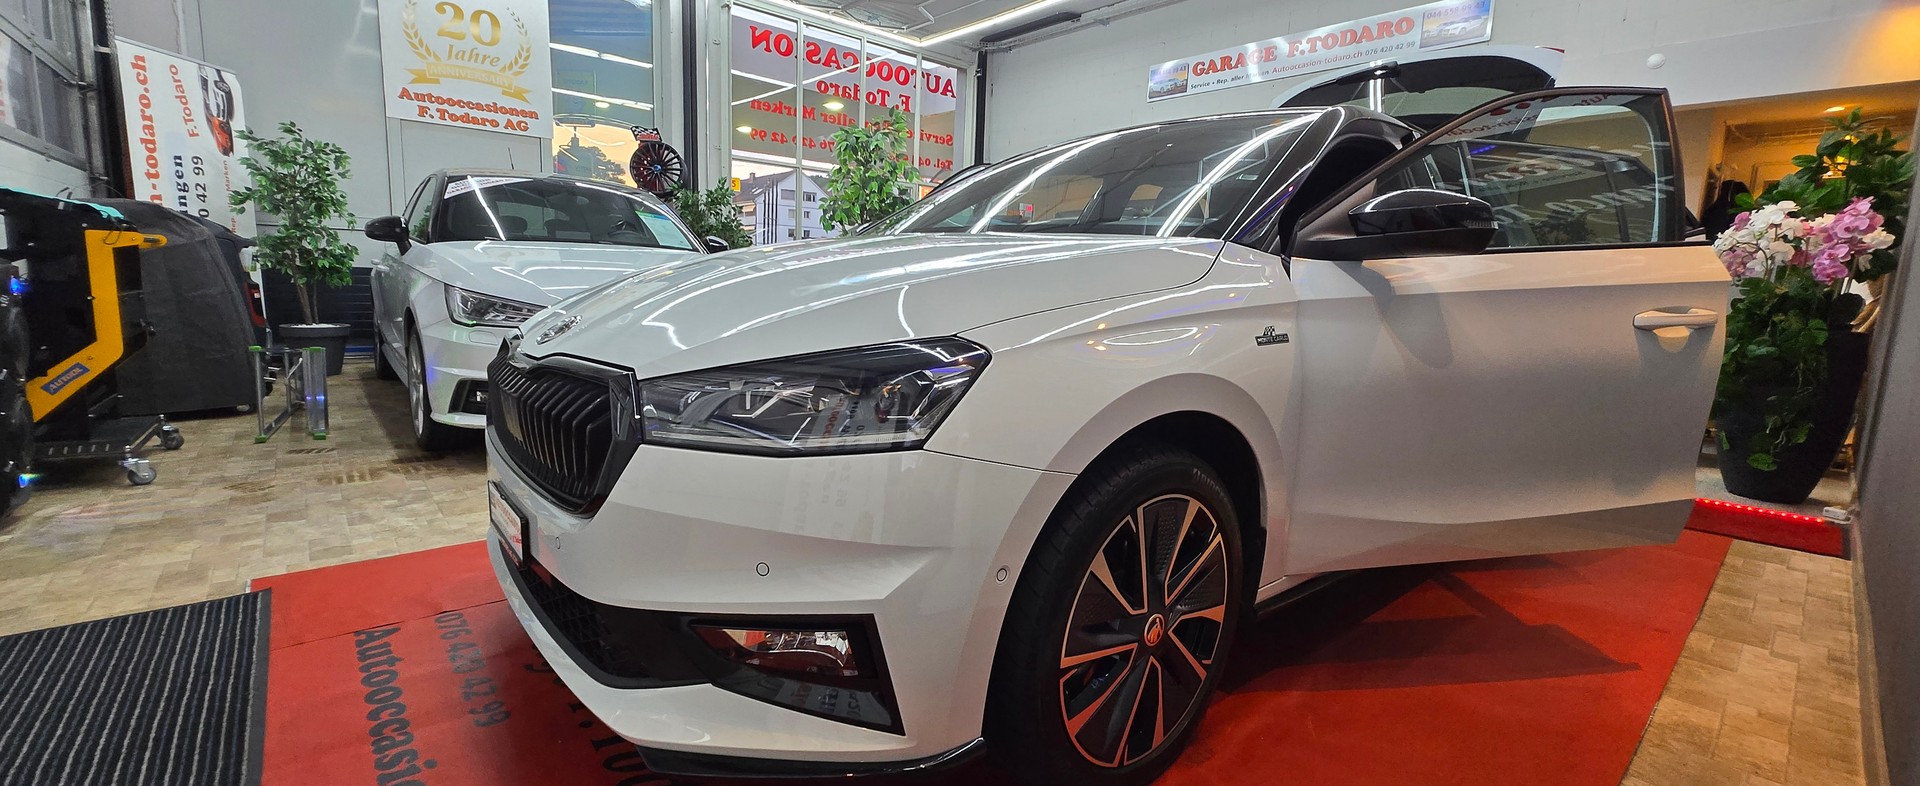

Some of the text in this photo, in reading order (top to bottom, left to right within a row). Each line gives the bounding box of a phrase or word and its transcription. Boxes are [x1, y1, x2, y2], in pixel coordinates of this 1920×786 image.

[435, 1, 501, 47] 20
[446, 44, 501, 67] Jahre
[1192, 16, 1415, 77] GARAGE F.TODARO
[429, 64, 509, 87] ANNIVERSARY
[1190, 80, 1211, 90] Service
[1216, 77, 1230, 85] Rep.
[1230, 74, 1245, 82] aller
[1364, 48, 1378, 56] 076
[1379, 45, 1394, 53] 420
[1405, 41, 1416, 49] 99
[398, 87, 539, 120] Autooccasionen
[417, 105, 530, 132] F. Todaro AG
[191, 155, 206, 177] 99
[194, 182, 210, 205] 42
[434, 612, 473, 641] 076
[460, 675, 498, 702] 42
[468, 700, 512, 728] 99
